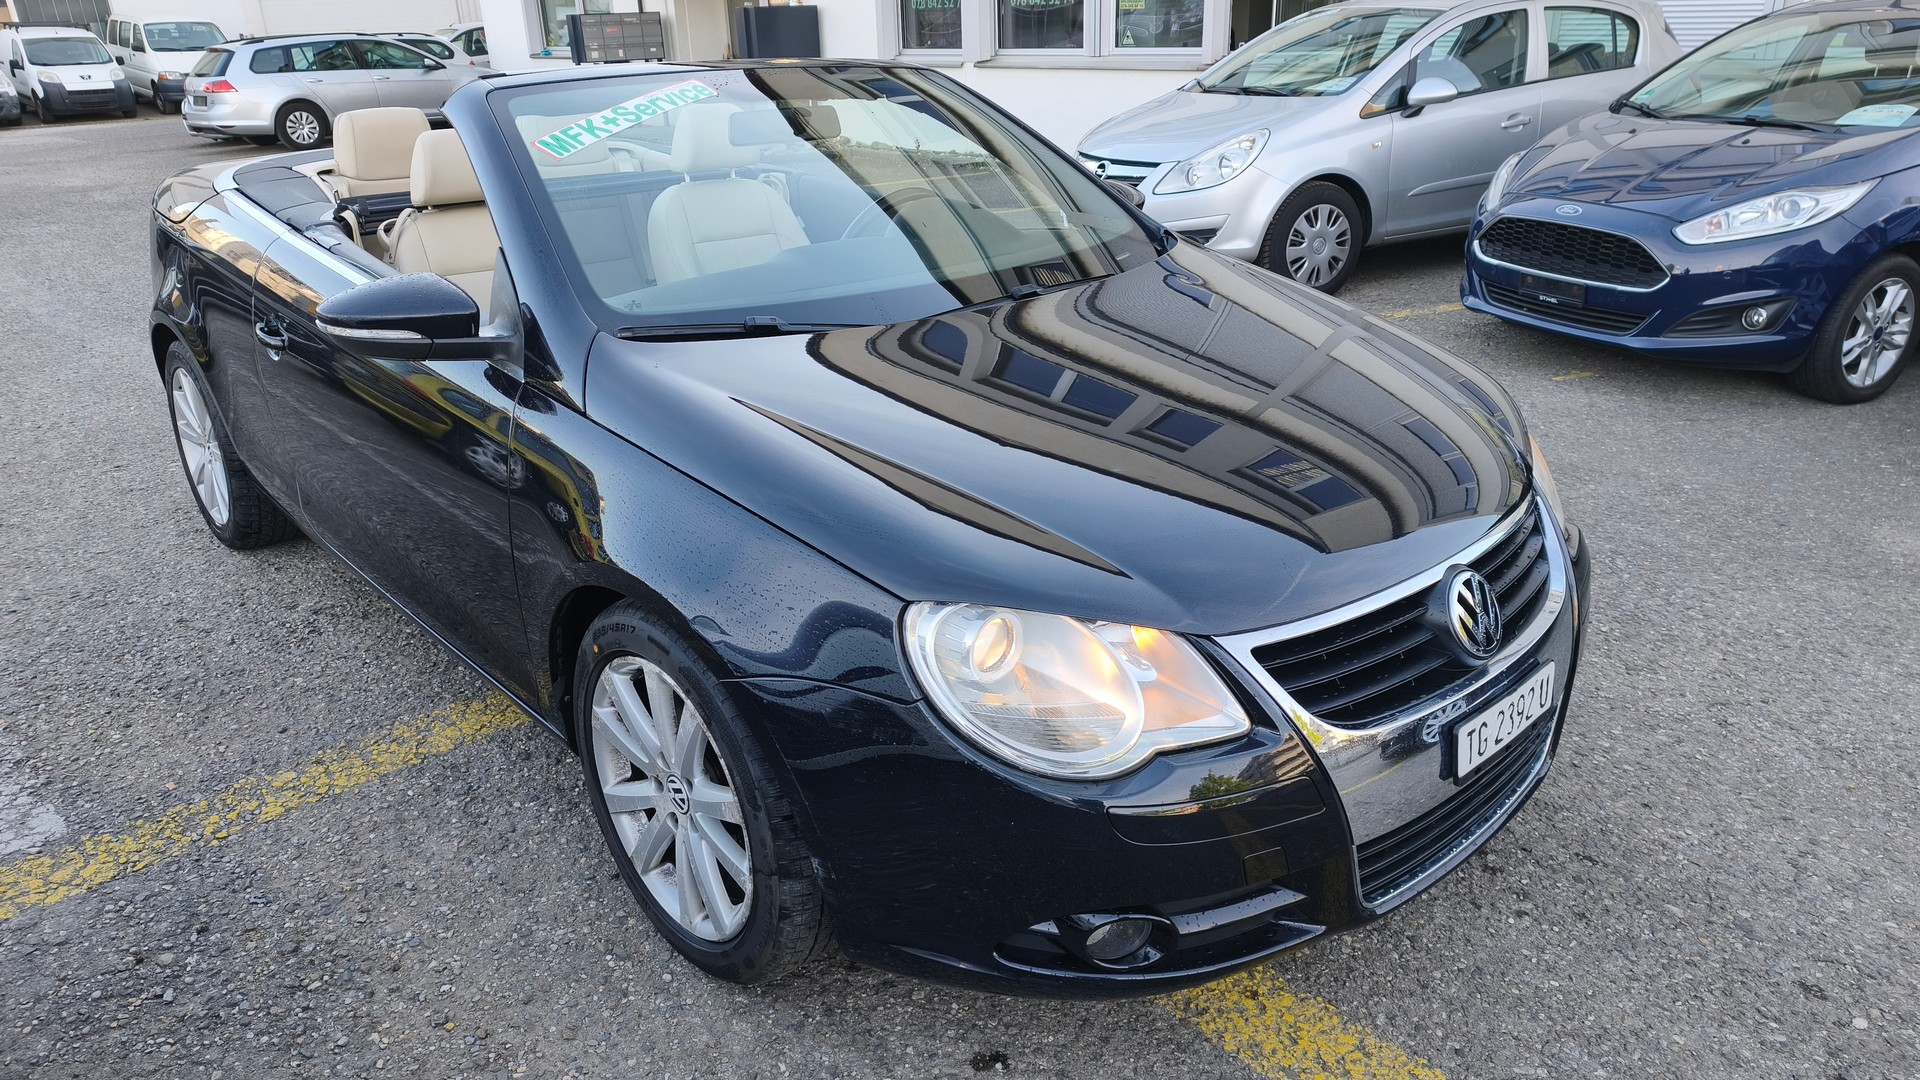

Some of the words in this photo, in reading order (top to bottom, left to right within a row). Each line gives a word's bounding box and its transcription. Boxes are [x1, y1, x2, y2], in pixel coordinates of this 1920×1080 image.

[536, 84, 716, 157] MFK+Service
[1467, 721, 1488, 765] TG
[1495, 686, 1536, 746] 2392
[1540, 673, 1551, 709] U
